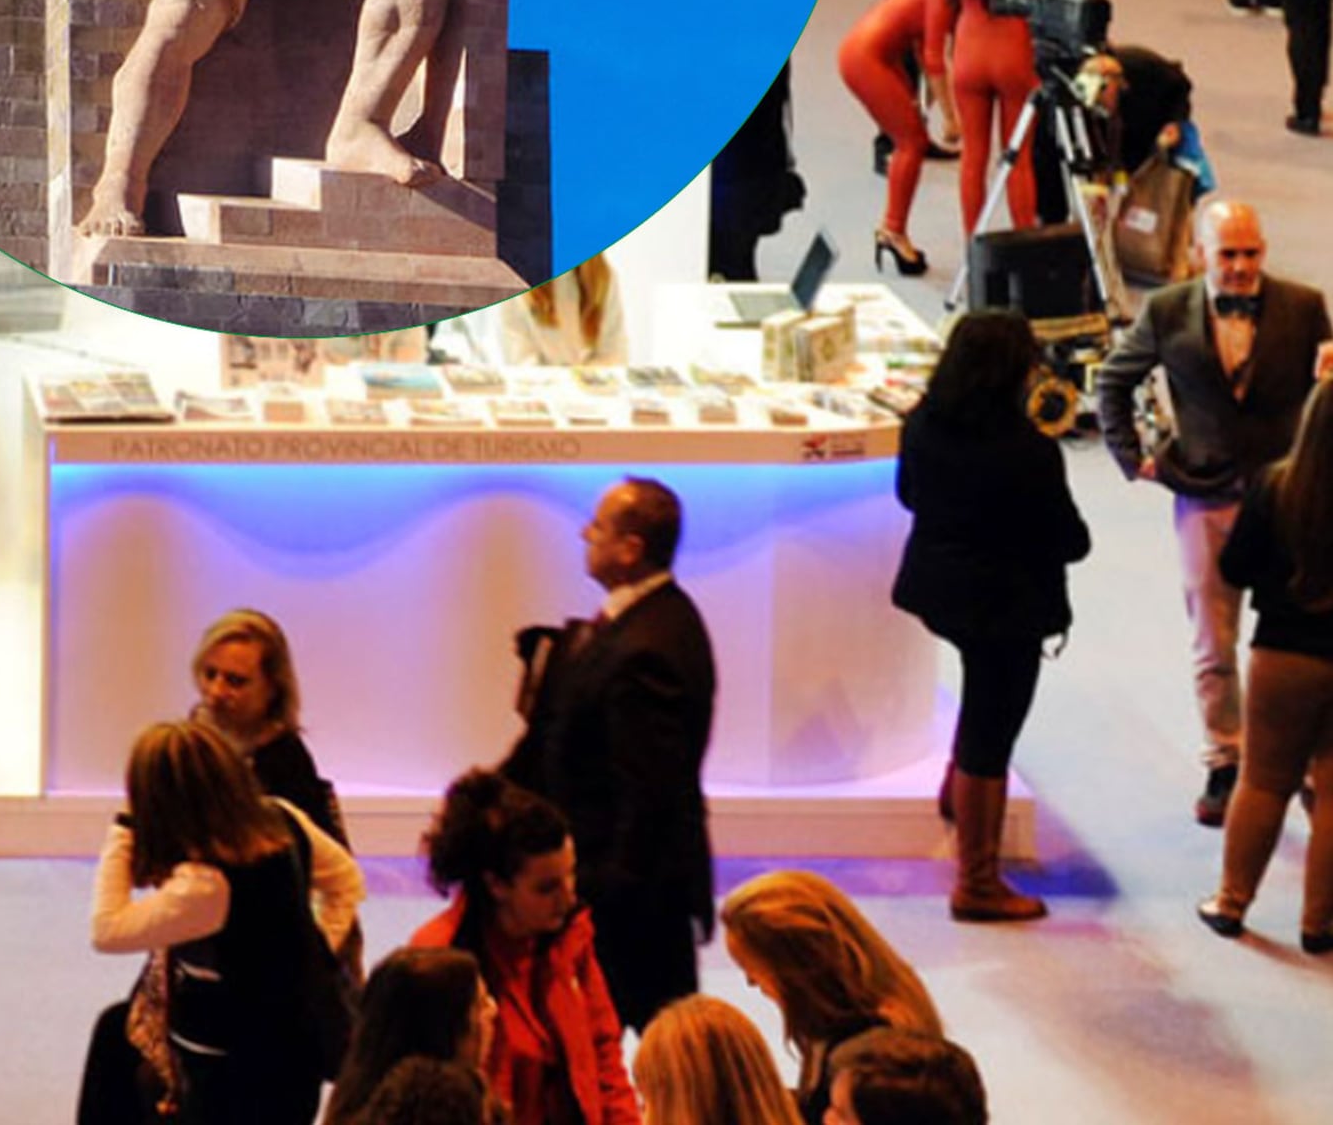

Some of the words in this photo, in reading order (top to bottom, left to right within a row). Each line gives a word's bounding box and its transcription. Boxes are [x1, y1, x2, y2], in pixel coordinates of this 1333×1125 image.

[111, 437, 266, 459] PATRONATO
[273, 436, 424, 459] PROVINCIAL
[432, 436, 468, 459] DE
[474, 435, 582, 459] TURISMO
